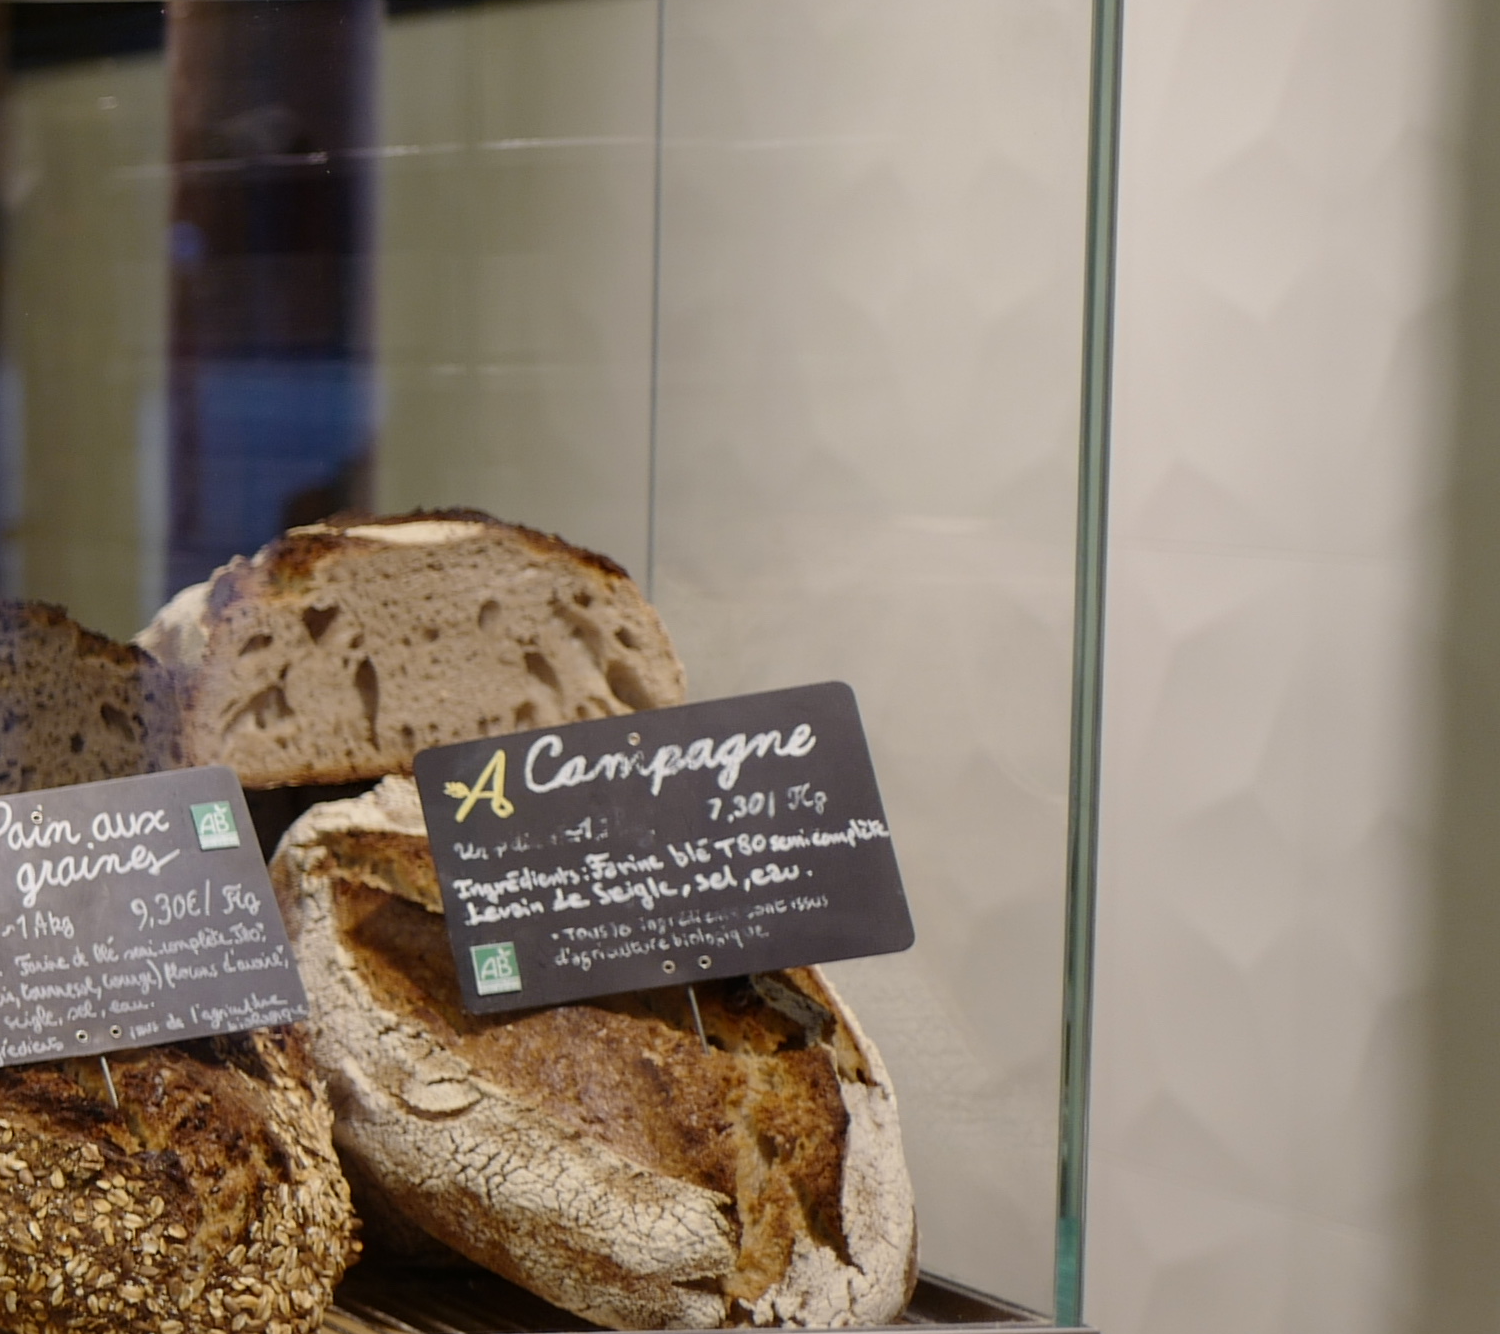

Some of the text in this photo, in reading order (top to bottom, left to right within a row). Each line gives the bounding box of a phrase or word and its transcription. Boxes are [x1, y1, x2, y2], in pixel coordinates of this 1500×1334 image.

[524, 722, 817, 796] Campagne
[91, 808, 169, 843] aux
[16, 841, 181, 907] graines
